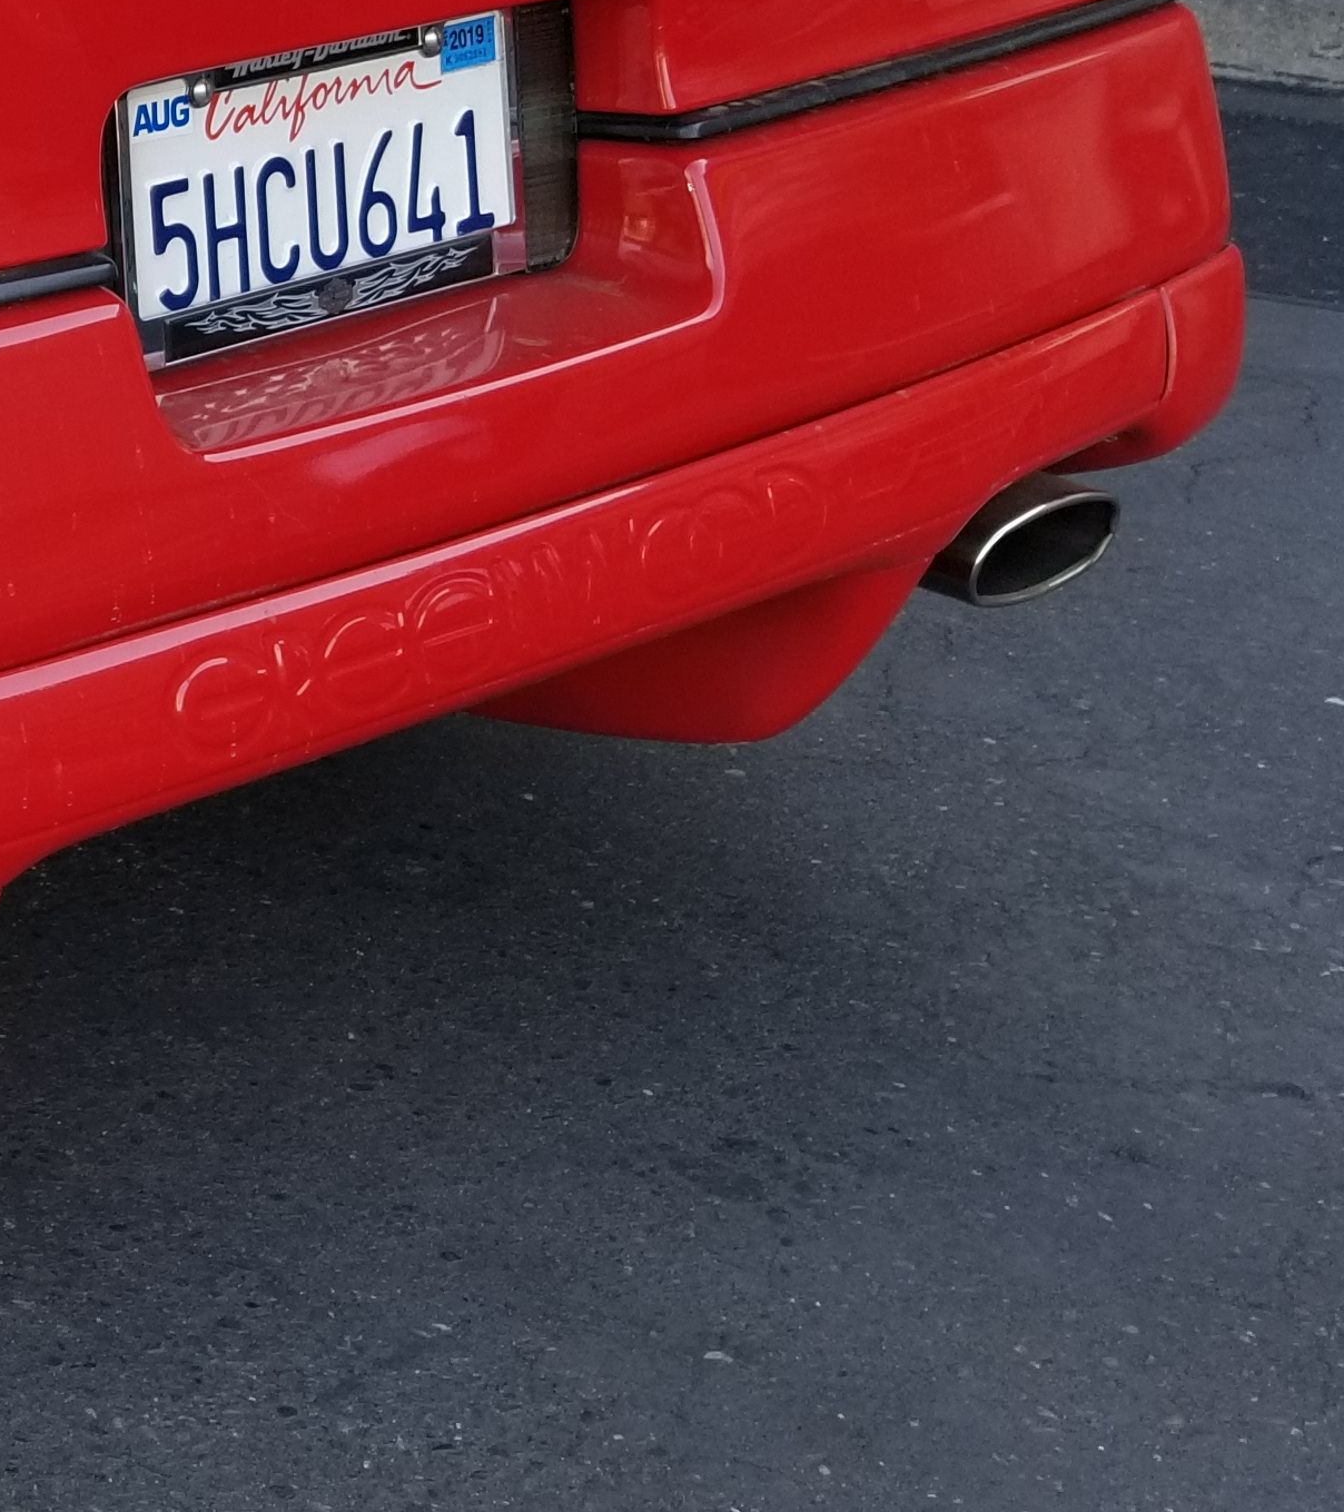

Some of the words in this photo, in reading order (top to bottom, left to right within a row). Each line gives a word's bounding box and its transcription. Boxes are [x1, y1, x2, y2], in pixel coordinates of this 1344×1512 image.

[449, 24, 484, 50] 2019
[132, 94, 191, 137] AUG
[204, 59, 443, 142] California
[148, 109, 495, 311] 5HCU641
